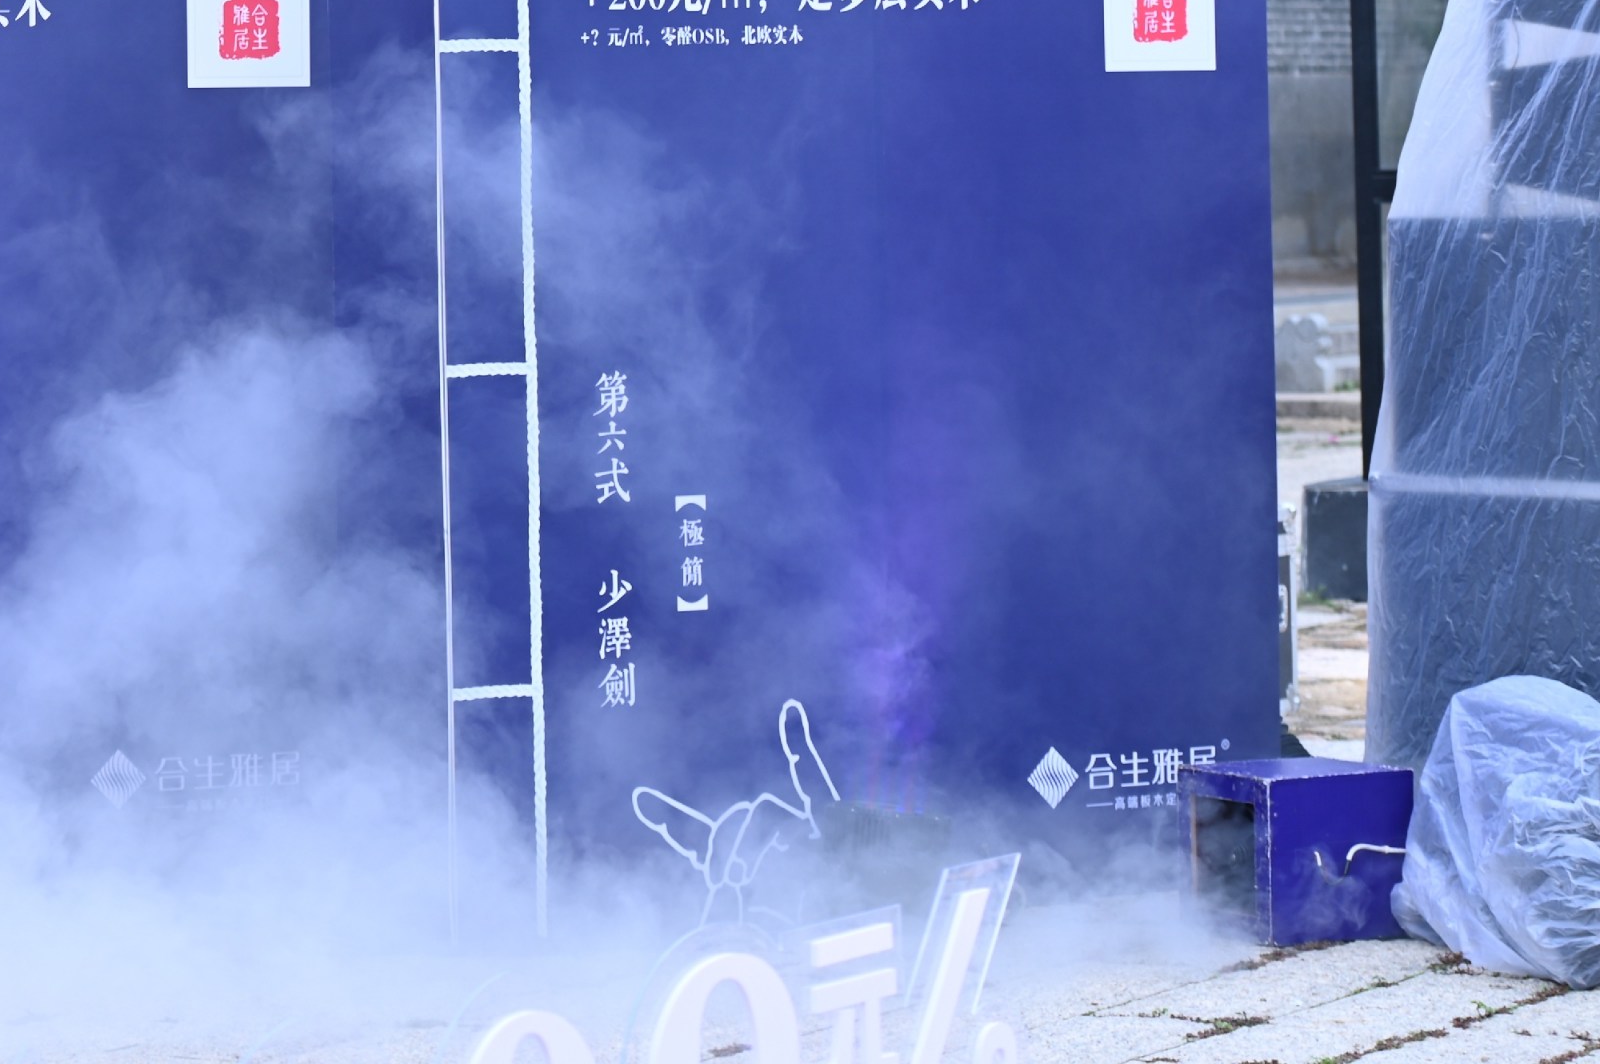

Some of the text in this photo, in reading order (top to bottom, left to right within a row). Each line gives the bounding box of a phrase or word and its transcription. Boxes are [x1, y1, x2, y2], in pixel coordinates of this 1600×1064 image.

[593, 371, 630, 504] 第六式
[155, 752, 299, 791] 合生雅居
